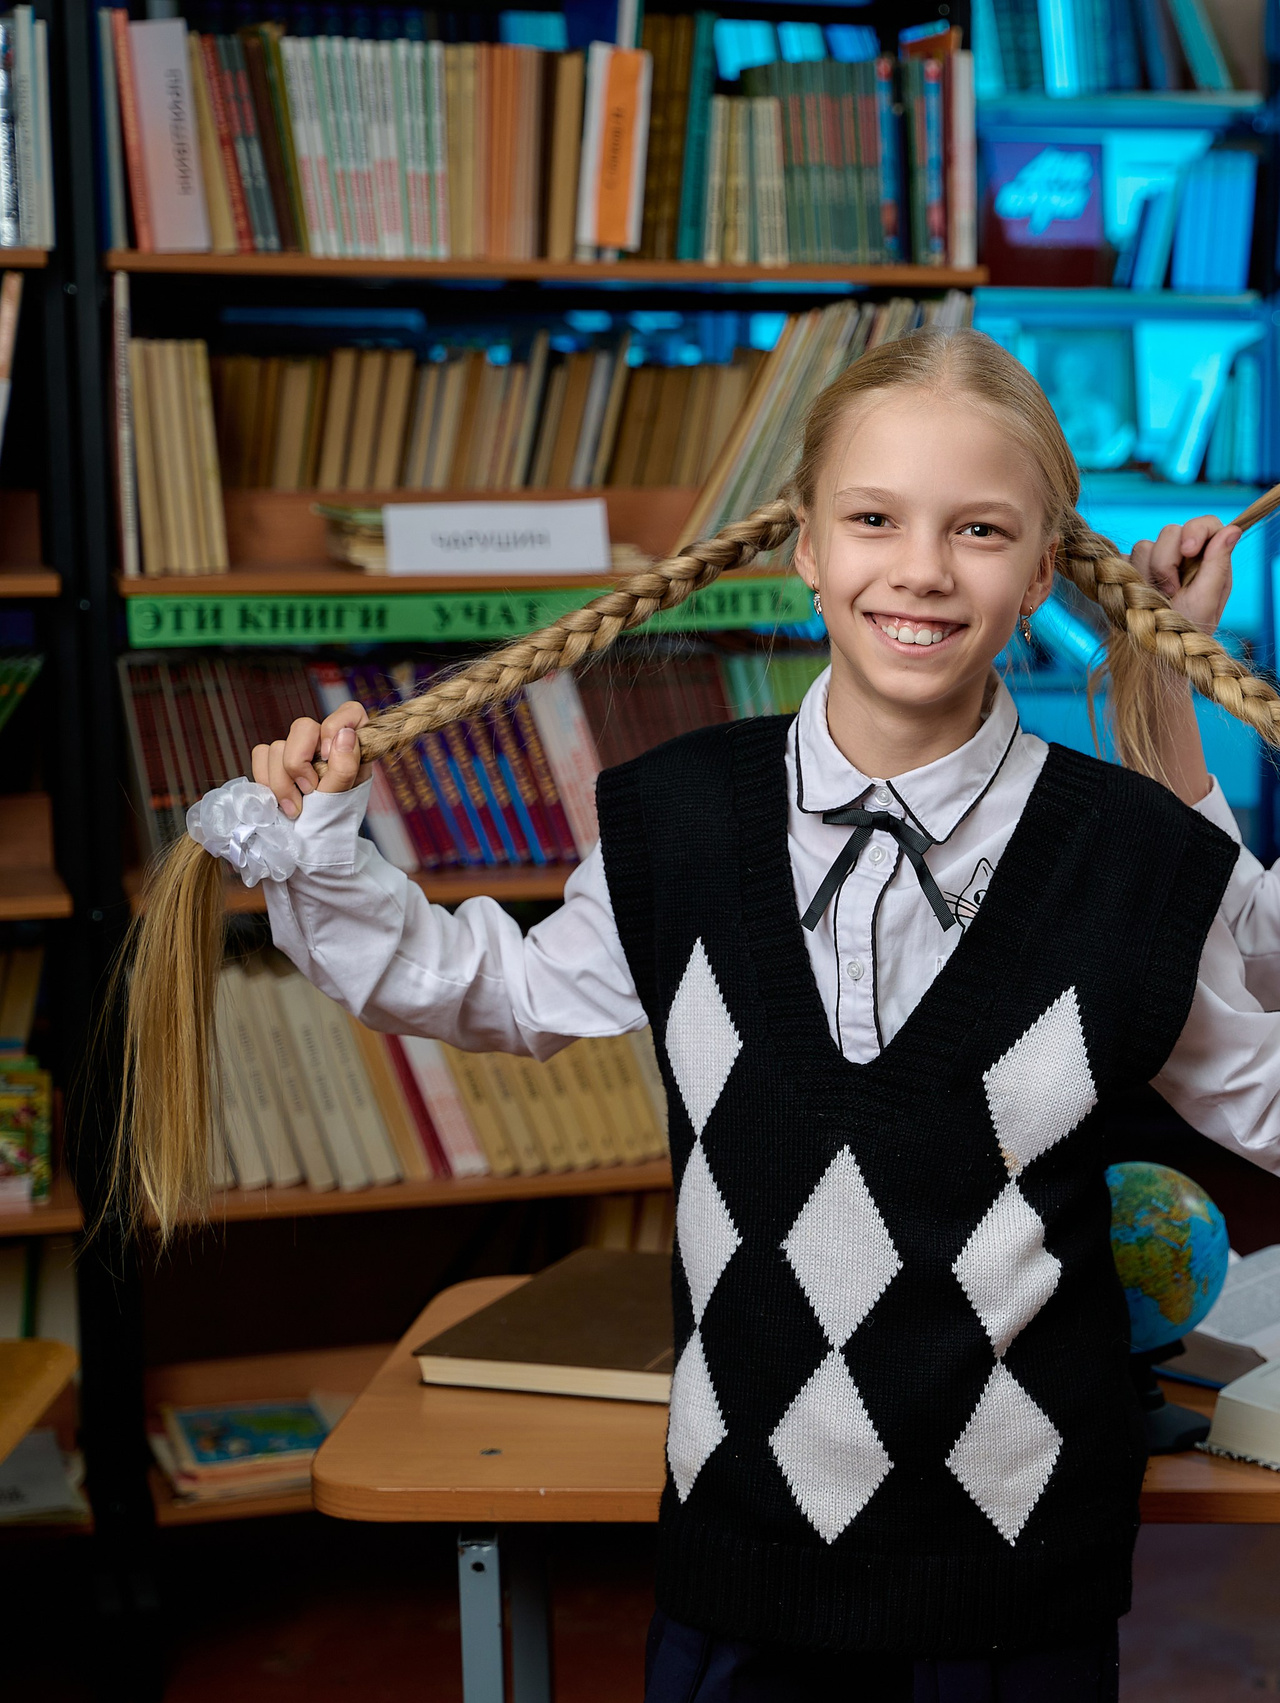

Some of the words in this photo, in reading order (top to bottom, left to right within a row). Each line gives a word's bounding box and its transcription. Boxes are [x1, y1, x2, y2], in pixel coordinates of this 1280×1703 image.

[431, 529, 551, 553] ЧАРУШИН
[135, 602, 224, 638] ЭТИ
[236, 602, 390, 632] КНИГИ
[432, 599, 546, 631] УЧАТ
